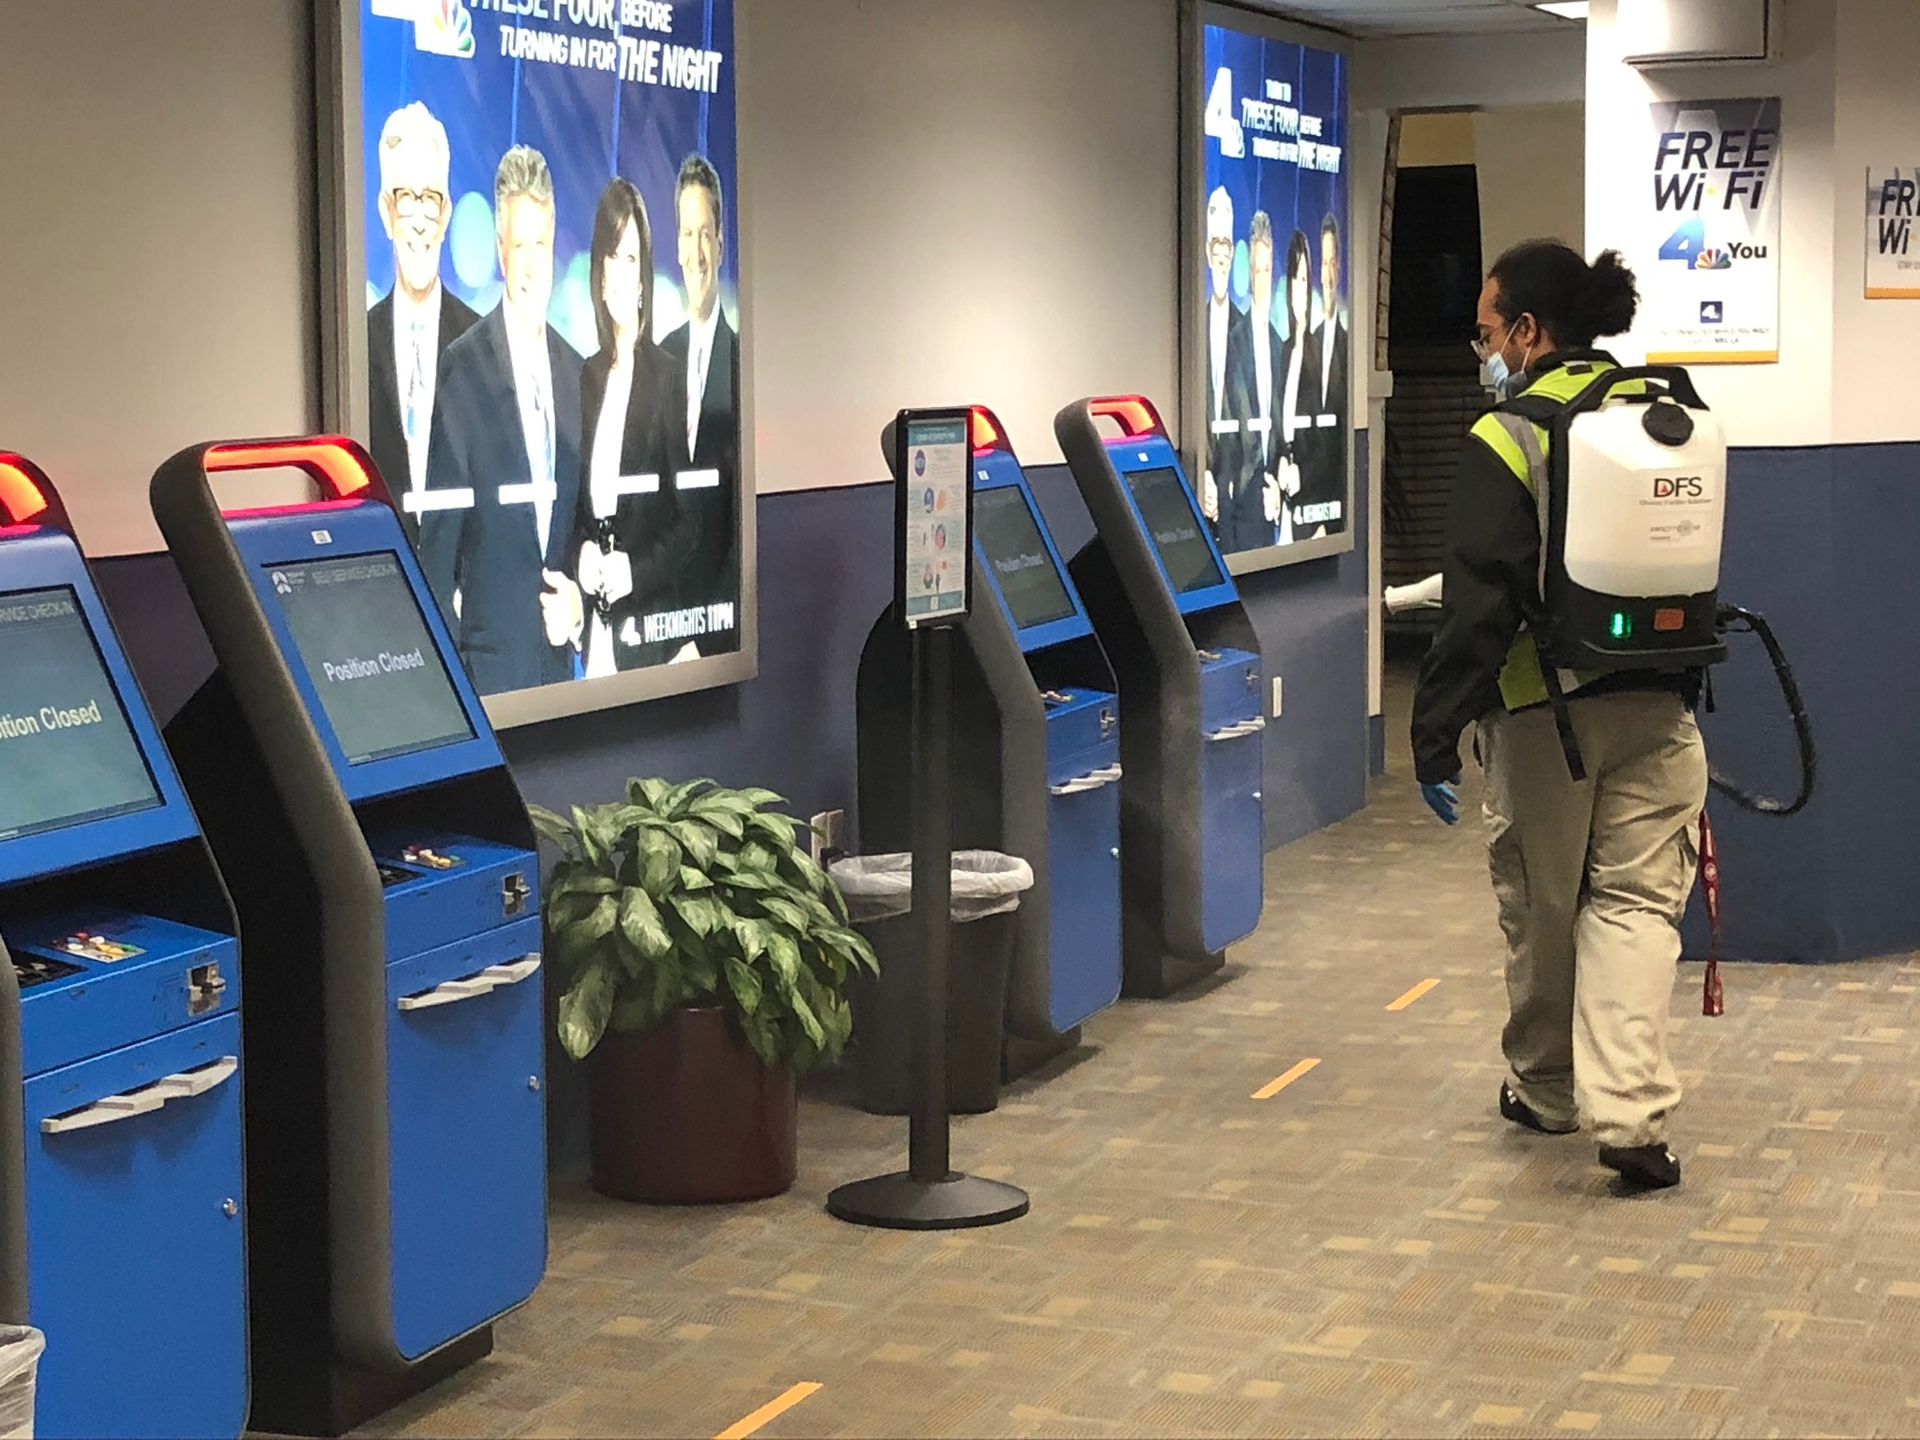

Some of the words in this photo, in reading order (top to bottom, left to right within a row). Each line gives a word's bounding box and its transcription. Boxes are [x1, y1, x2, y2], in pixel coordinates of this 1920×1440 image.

[621, 0, 673, 33] BEFORE
[500, 25, 568, 65] TURNING
[570, 37, 587, 68] IN
[588, 40, 616, 72] FOR
[618, 35, 660, 84] THE
[661, 44, 722, 93] NIGHT
[1655, 129, 1776, 171] FREE
[1879, 179, 1920, 216] FR
[1658, 219, 1704, 270] 4
[1727, 242, 1767, 259] You
[1653, 476, 1703, 498] DFS
[643, 606, 706, 643] WEEKNIGHTS
[707, 602, 734, 632] 11PM
[322, 657, 381, 683] Position
[379, 647, 427, 674] Closed
[0, 713, 41, 739] ition
[40, 699, 102, 731] Closed
